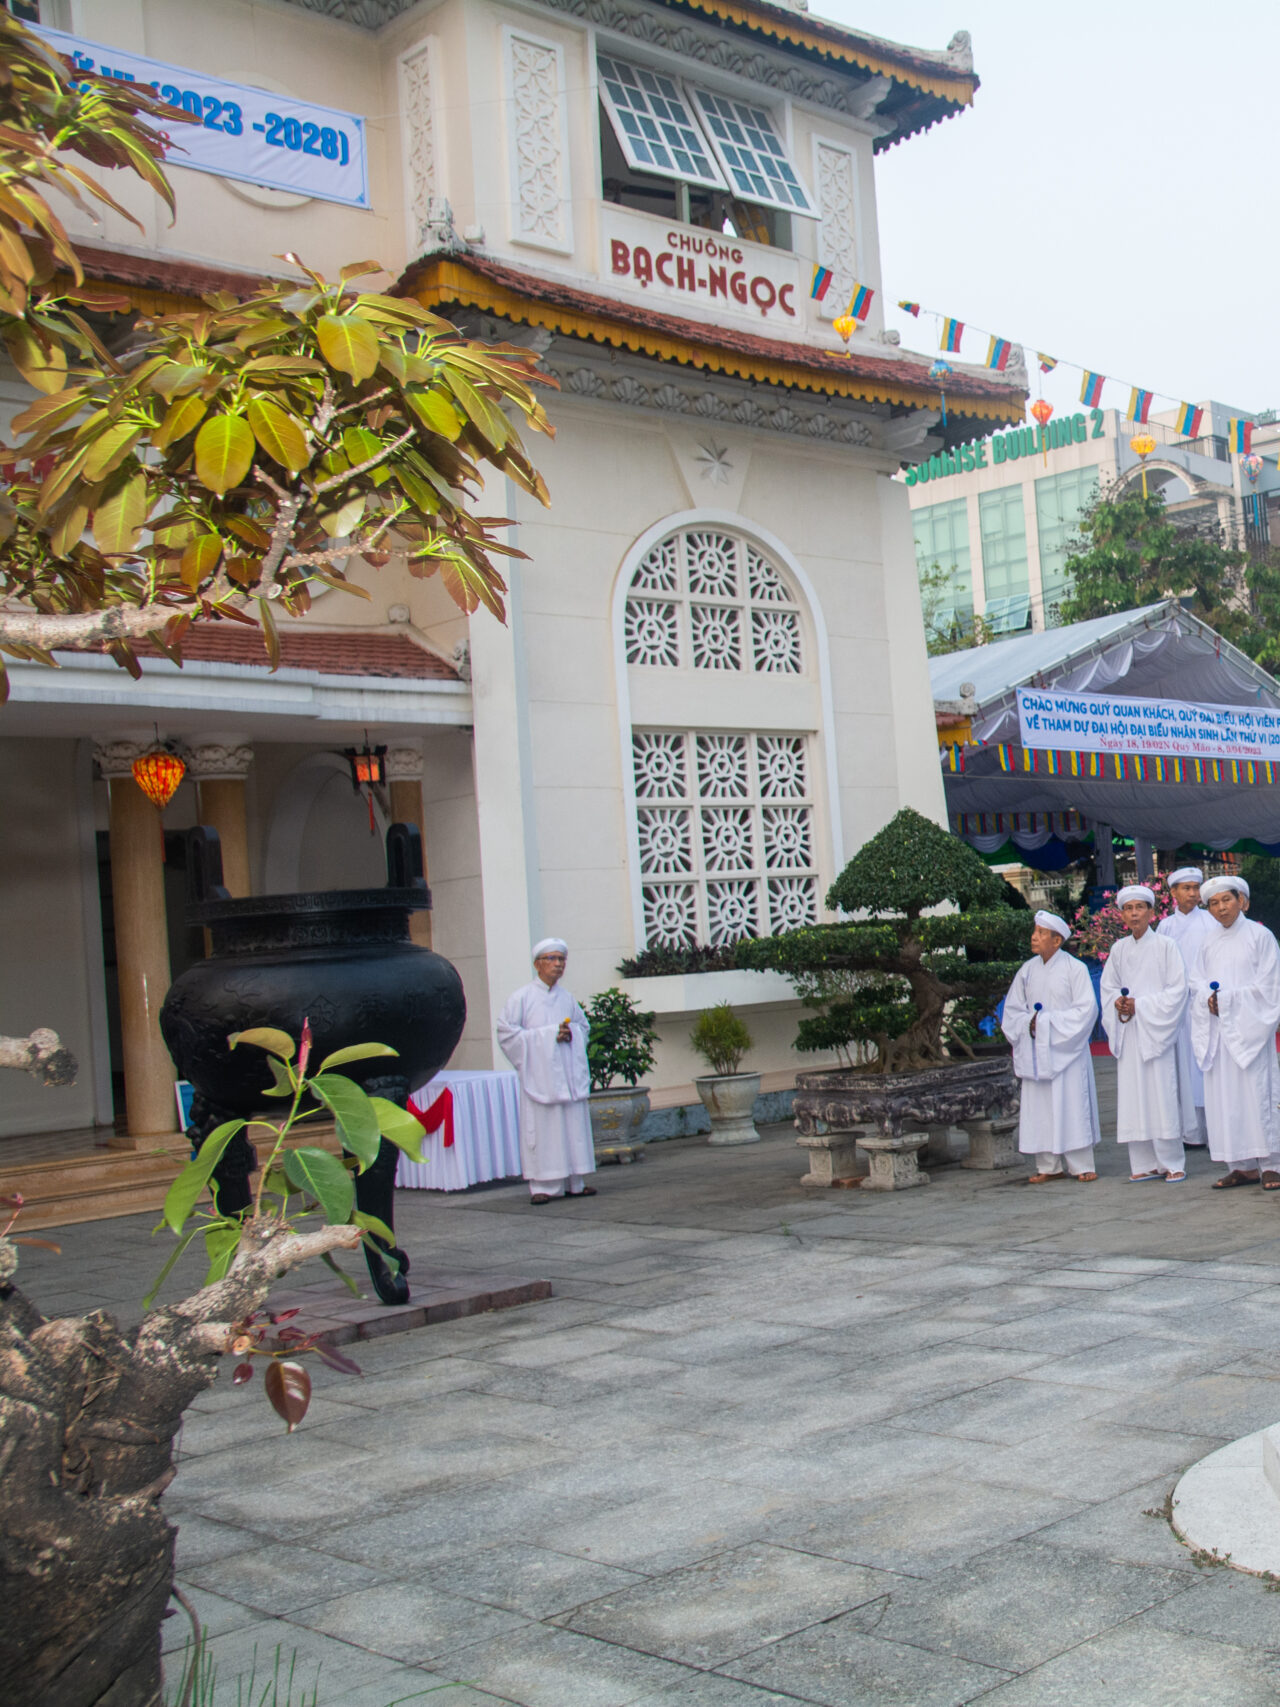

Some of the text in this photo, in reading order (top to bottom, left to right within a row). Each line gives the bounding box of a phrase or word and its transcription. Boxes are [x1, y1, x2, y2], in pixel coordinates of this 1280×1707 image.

[667, 231, 744, 264] CHUÔNG
[610, 238, 796, 317] BẠCH-NGỌC
[992, 412, 1087, 464] BUILDING
[1090, 408, 1105, 439] 2
[1022, 695, 1053, 712] CHÀO
[1055, 698, 1087, 714] MỪNG
[1089, 700, 1111, 716] QUÝ
[1113, 704, 1141, 718] QUAN
[1143, 705, 1177, 722] KHÁCH,
[1178, 708, 1198, 722] QUÝ
[1238, 713, 1254, 729] HỘI
[1255, 714, 1275, 728] VIÊN
[1025, 713, 1040, 730] VỀ
[1041, 717, 1072, 732] THAM
[1073, 719, 1090, 736] DỰ
[1091, 721, 1108, 737] ĐẠI
[1110, 720, 1128, 738] HỘI
[1130, 723, 1147, 739] ĐẠI
[1148, 722, 1169, 737] BIỂU
[1170, 724, 1197, 739] NHÂN
[1198, 728, 1219, 741] SINH
[1239, 729, 1257, 744] THỨ
[1258, 732, 1267, 744] VI
